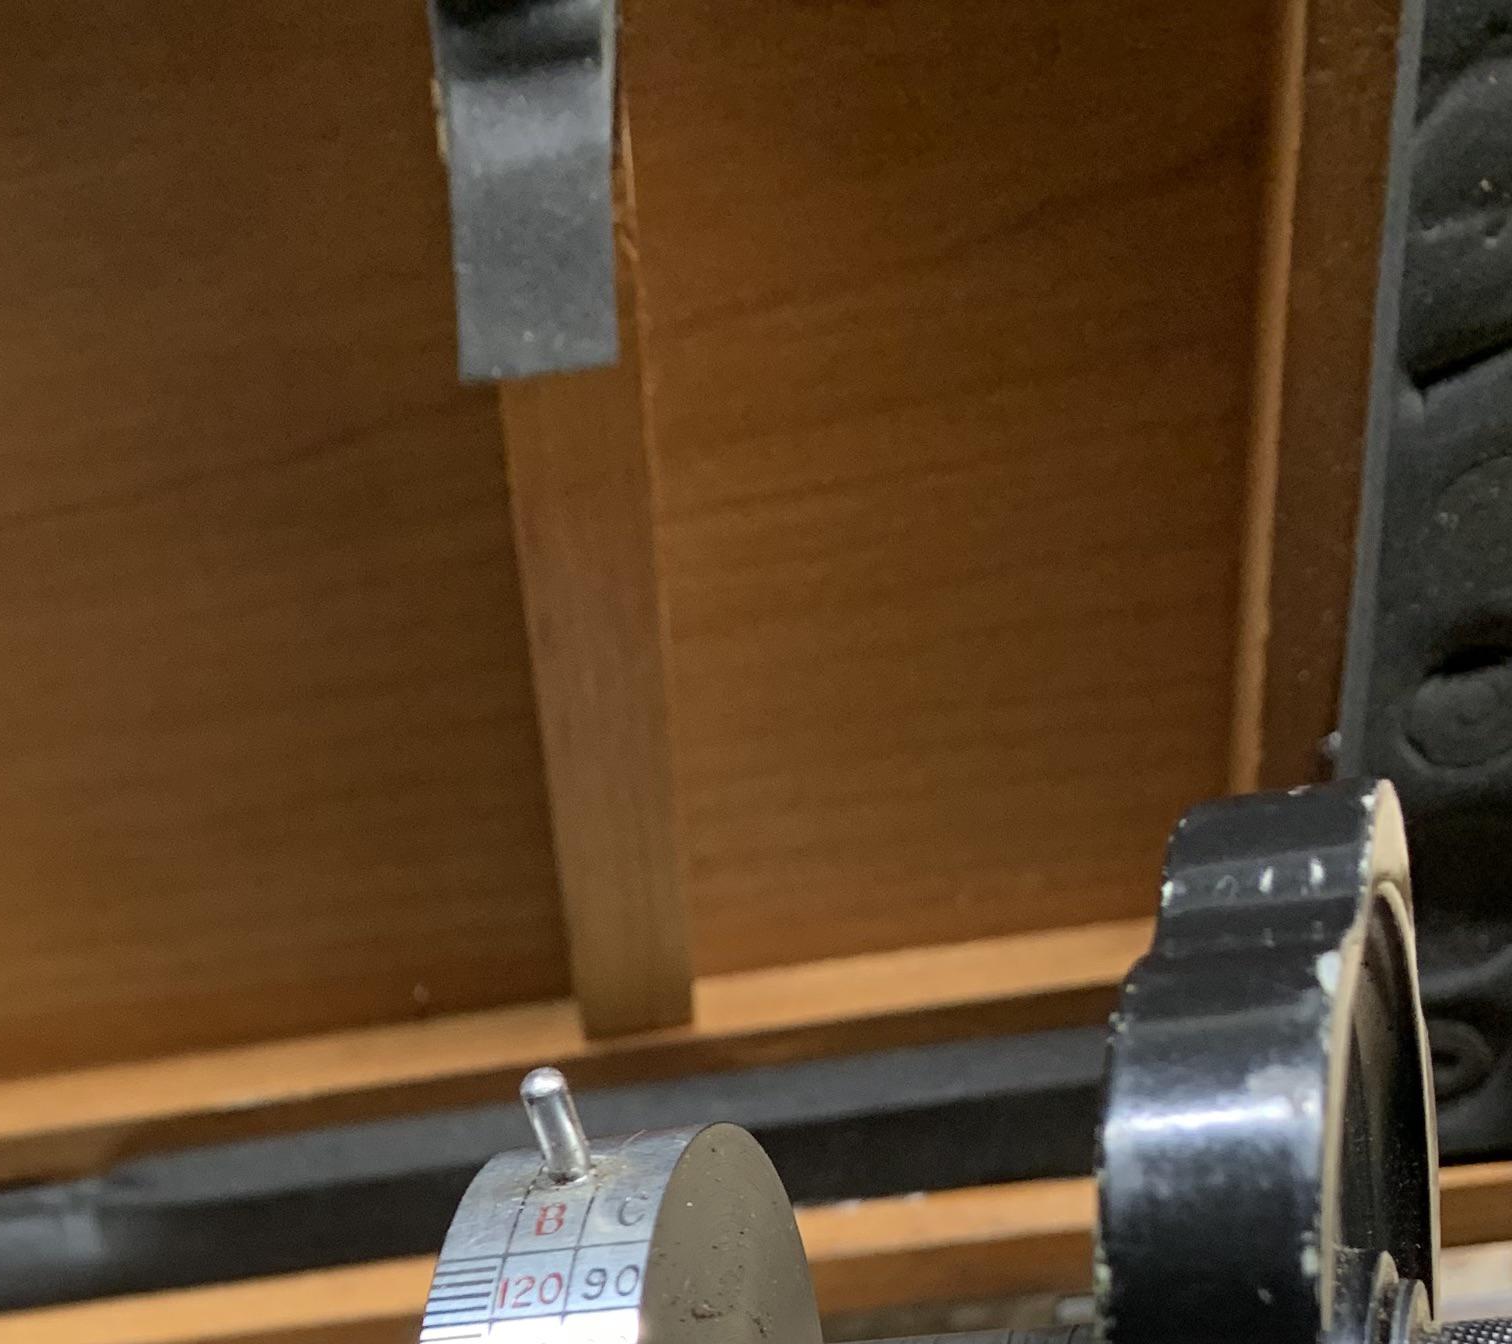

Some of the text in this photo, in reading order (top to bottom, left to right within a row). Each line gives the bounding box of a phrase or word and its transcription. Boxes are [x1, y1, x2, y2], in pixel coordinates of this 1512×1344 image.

[535, 1195, 649, 1236] B C
[497, 1264, 639, 1309] 120 90
